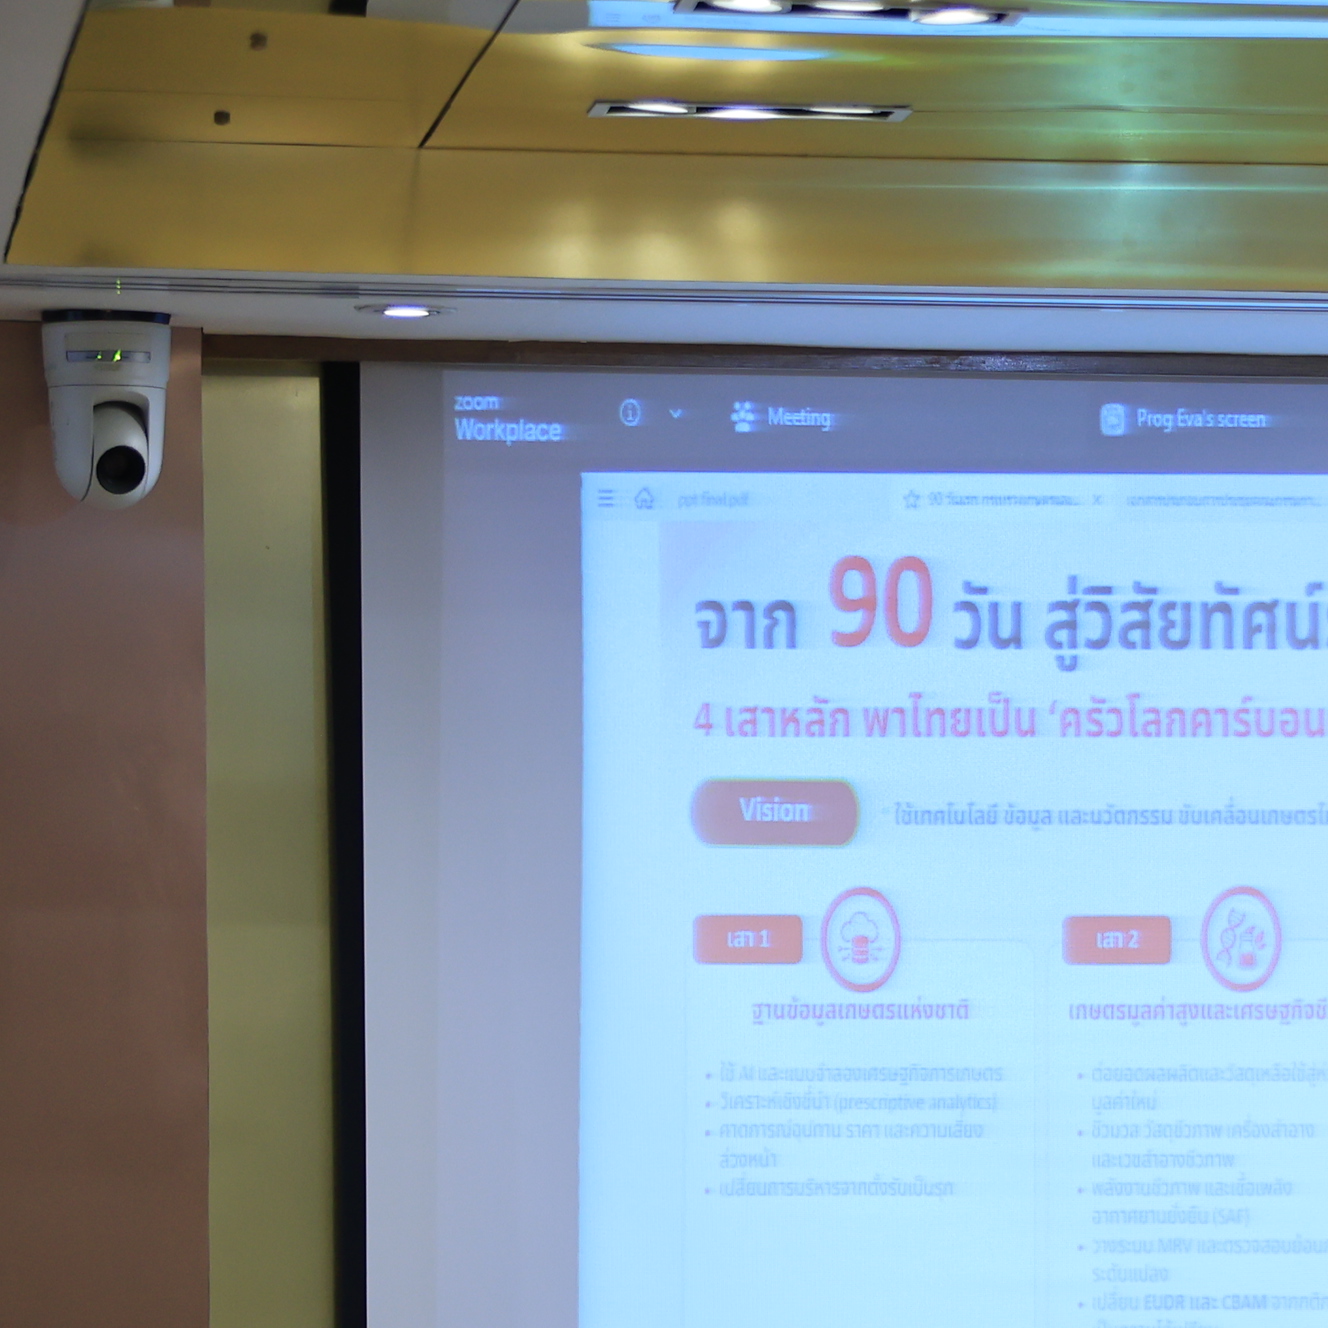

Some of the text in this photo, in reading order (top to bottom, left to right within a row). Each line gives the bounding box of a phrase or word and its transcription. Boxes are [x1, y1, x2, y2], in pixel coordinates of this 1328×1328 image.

[455, 394, 498, 411] zoom
[455, 417, 562, 444] Workplace
[767, 406, 832, 432] Meeting
[1137, 408, 1174, 431] Prog
[1217, 410, 1266, 428] screen
[695, 594, 797, 651] จาก
[827, 554, 934, 648] 90
[953, 582, 1023, 651] วัน
[694, 705, 713, 736] 4
[724, 694, 851, 739] เสาหลัก
[863, 691, 1037, 739] พาไทยเป็น
[739, 797, 809, 822] Vision
[895, 801, 997, 826] ใช้เทคโนโลยี
[1004, 802, 1052, 831] ข้อมูล
[1058, 802, 1173, 826] และนวัตกรรม
[727, 929, 769, 949] เสา 1
[1096, 930, 1140, 949] เสา 2
[752, 997, 970, 1026] ฐานข้อมูลเกษตรแห่งชาติ
[1158, 1238, 1192, 1253] MRV
[1145, 1295, 1184, 1310] EUDR
[1190, 1295, 1217, 1310] และ
[1222, 1295, 1267, 1310] CBAM
